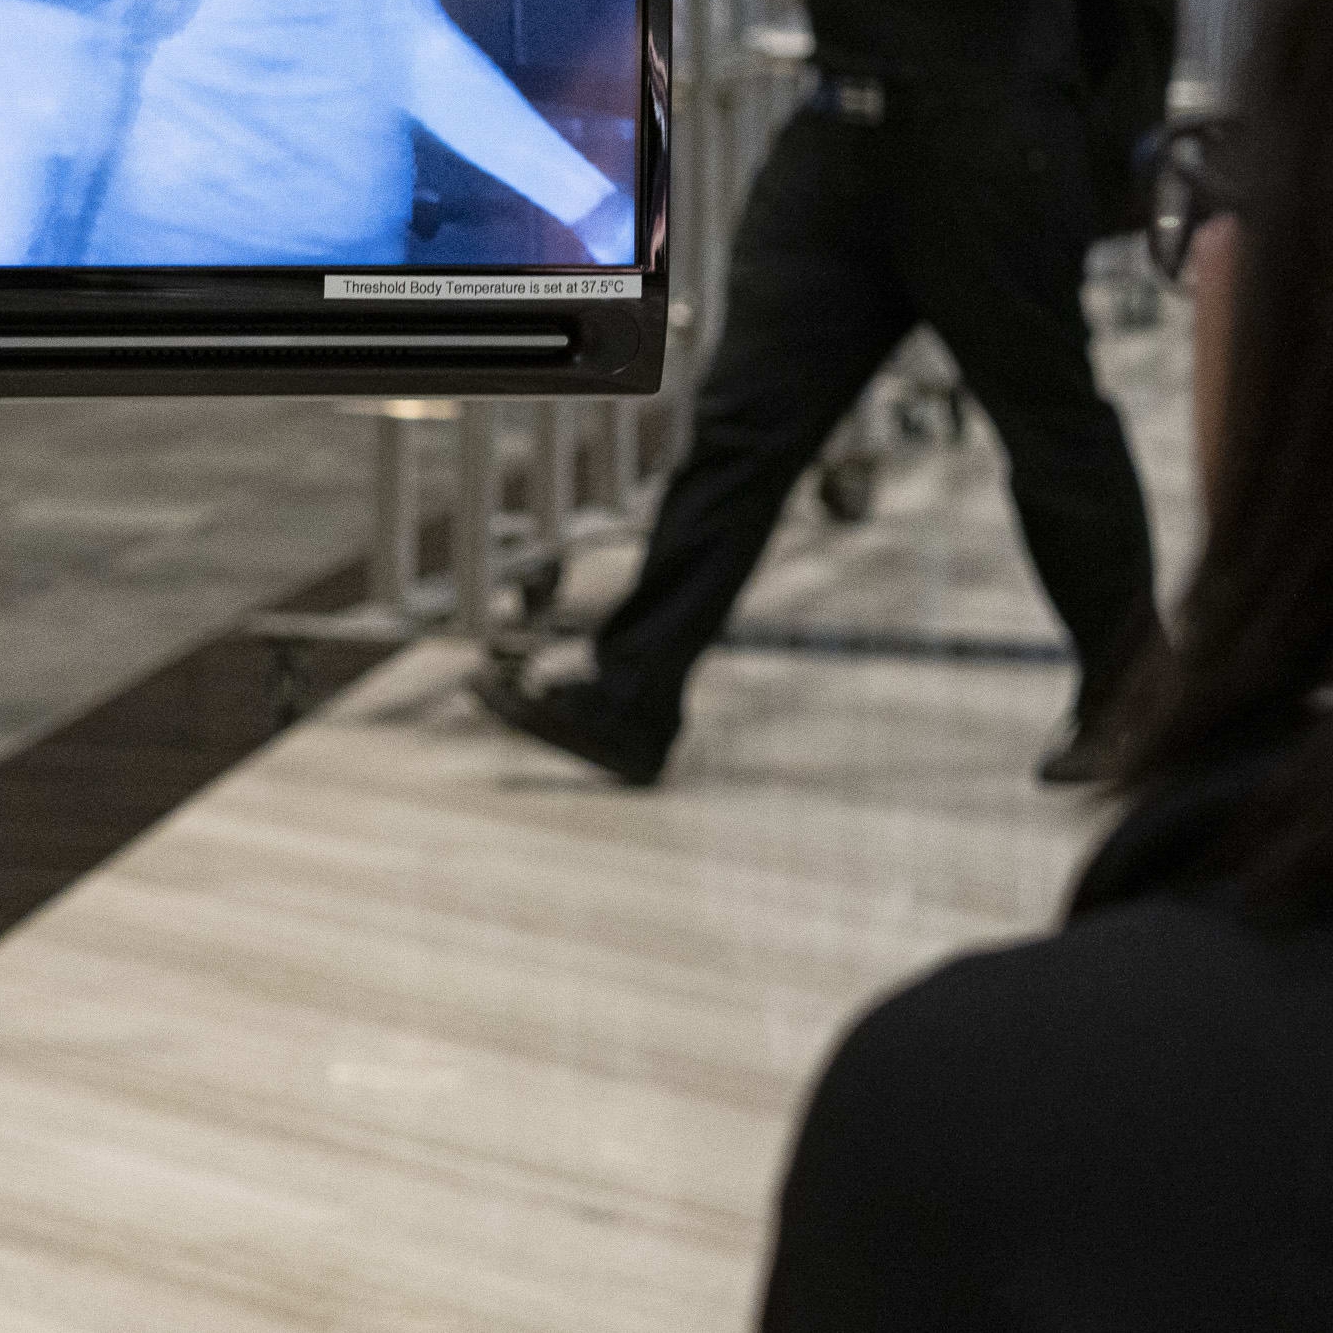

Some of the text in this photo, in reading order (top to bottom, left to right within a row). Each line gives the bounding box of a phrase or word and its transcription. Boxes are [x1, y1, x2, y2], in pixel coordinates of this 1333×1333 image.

[343, 280, 406, 294] Threshold
[410, 280, 442, 296] Body
[445, 281, 526, 296] Temperature
[530, 281, 540, 294] is
[544, 282, 562, 294] set
[566, 282, 578, 294] at
